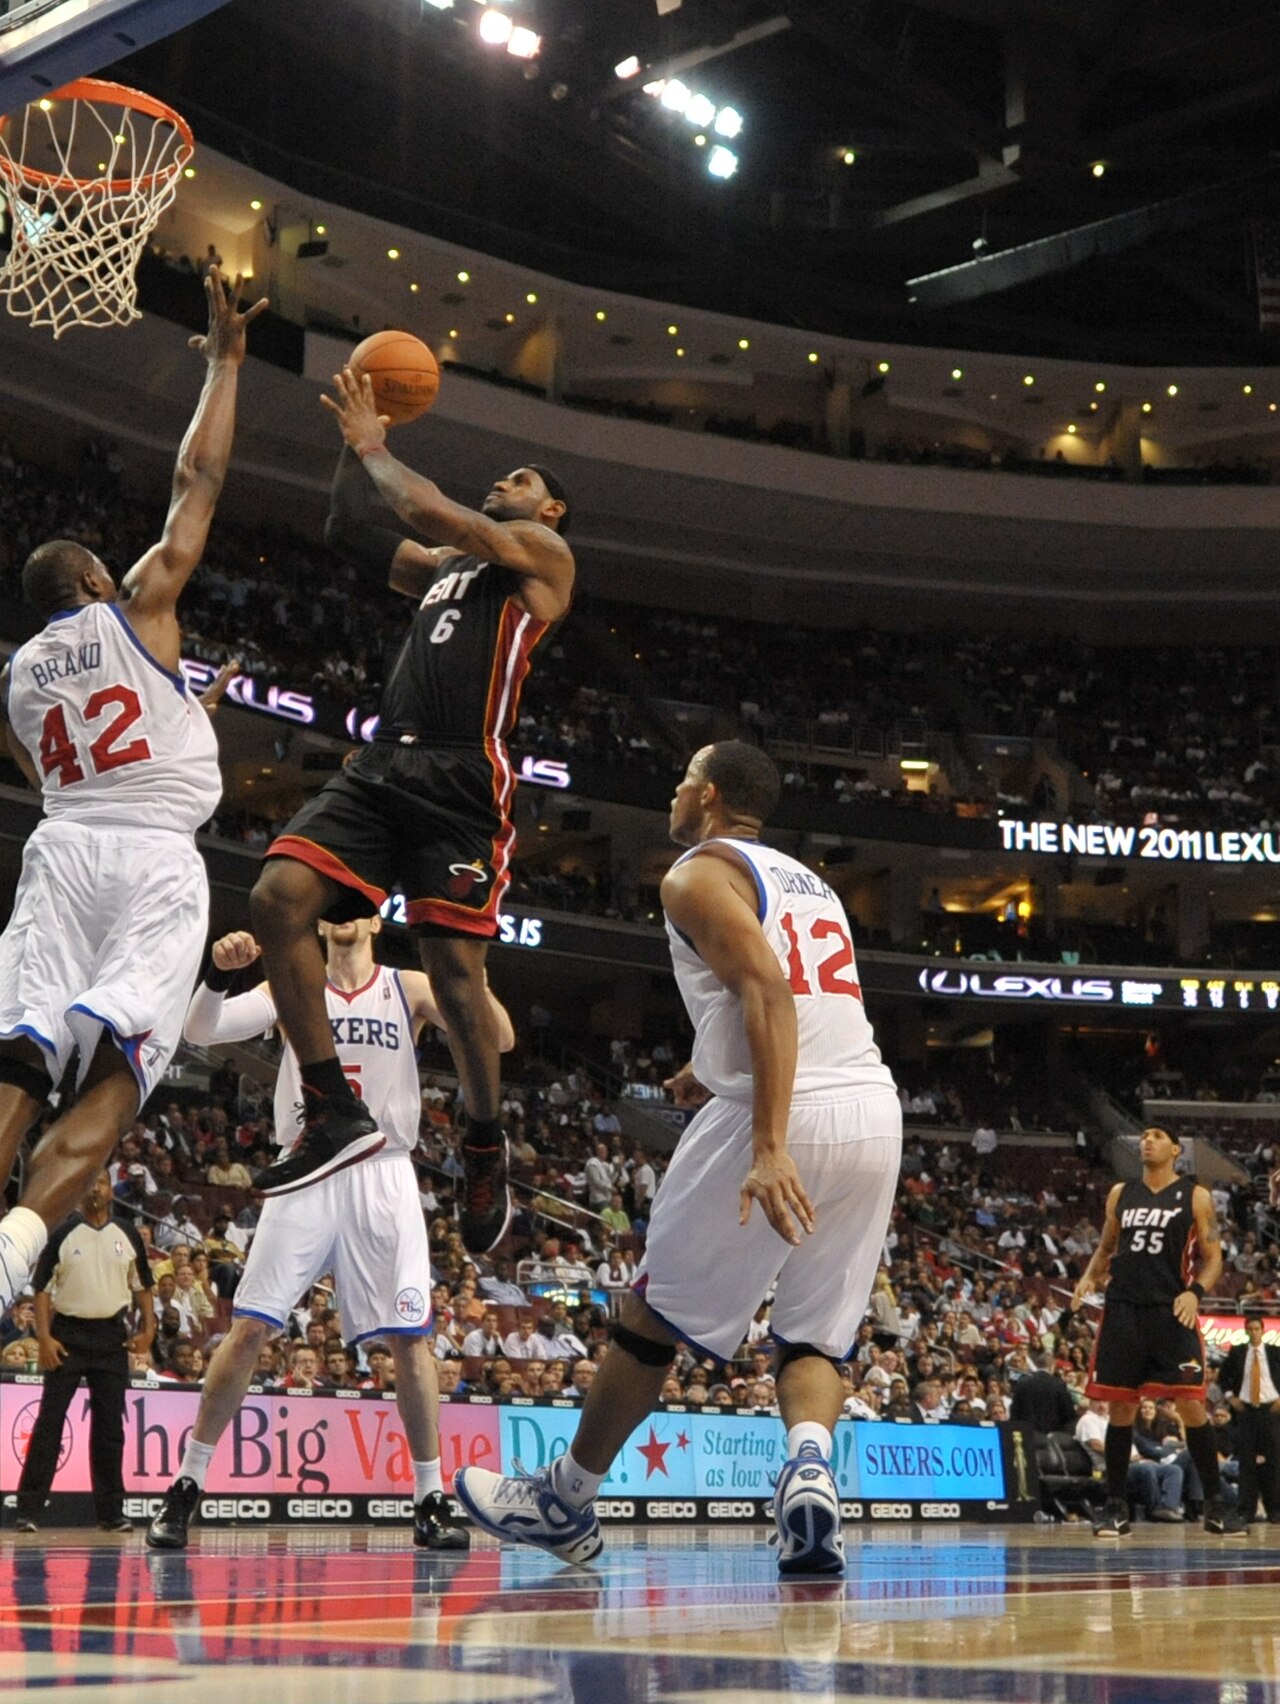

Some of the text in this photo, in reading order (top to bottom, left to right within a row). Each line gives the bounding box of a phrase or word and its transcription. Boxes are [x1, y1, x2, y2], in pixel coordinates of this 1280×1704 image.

[429, 608, 462, 644] 6
[30, 642, 101, 689] BRAND
[38, 683, 153, 790] 42
[998, 820, 1058, 853] THE
[1062, 823, 1136, 857] NEW
[1138, 828, 1202, 861] 2011
[780, 911, 861, 1001] 12
[970, 973, 1114, 1001] LEXUS
[1121, 1206, 1183, 1229] HEAT
[1130, 1229, 1165, 1255] 55
[229, 1405, 330, 1494] Big
[344, 1409, 494, 1483] Vaue
[702, 1428, 776, 1463] Starting
[705, 1468, 725, 1488] as
[730, 1461, 762, 1488] low
[865, 1444, 997, 1478] SIXERS.COM
[201, 1500, 271, 1519] GEICO
[287, 1500, 352, 1518] GEICO
[368, 1500, 415, 1518] GEIC
[646, 1502, 696, 1518] GEICO
[707, 1502, 756, 1518] GEICO
[870, 1503, 912, 1519] GEICO
[920, 1503, 960, 1518] GEICO
